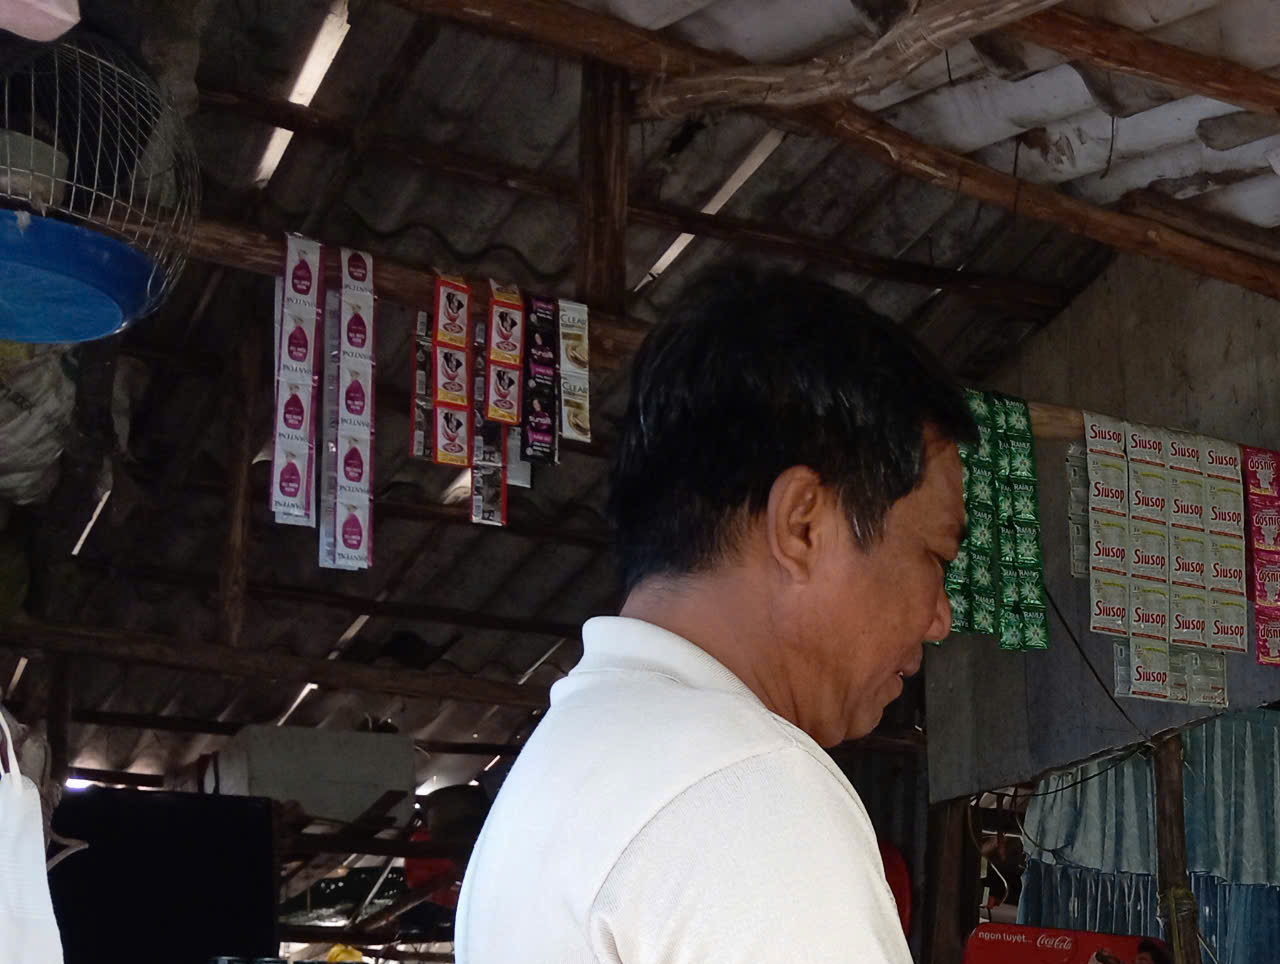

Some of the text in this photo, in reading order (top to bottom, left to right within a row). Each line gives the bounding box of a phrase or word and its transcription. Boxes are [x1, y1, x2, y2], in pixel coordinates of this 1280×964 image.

[1090, 424, 1122, 444] Siusop
[1131, 434, 1162, 453] Siusop
[1208, 451, 1238, 470] Siusop
[1093, 482, 1124, 502] Siusop
[1134, 490, 1165, 511] Siusop
[1211, 506, 1242, 524] Siusop
[1094, 541, 1125, 561] Siusop
[1133, 549, 1165, 569] Siusop
[1174, 556, 1204, 576] Siusop
[1213, 563, 1243, 582] Siusop
[1094, 600, 1126, 620] Siusop
[1134, 607, 1166, 627] Siusop
[1175, 614, 1205, 633] Siusop
[1213, 620, 1244, 640] Siusop
[1135, 666, 1167, 685] Siusop
[979, 931, 1000, 942] ngon
